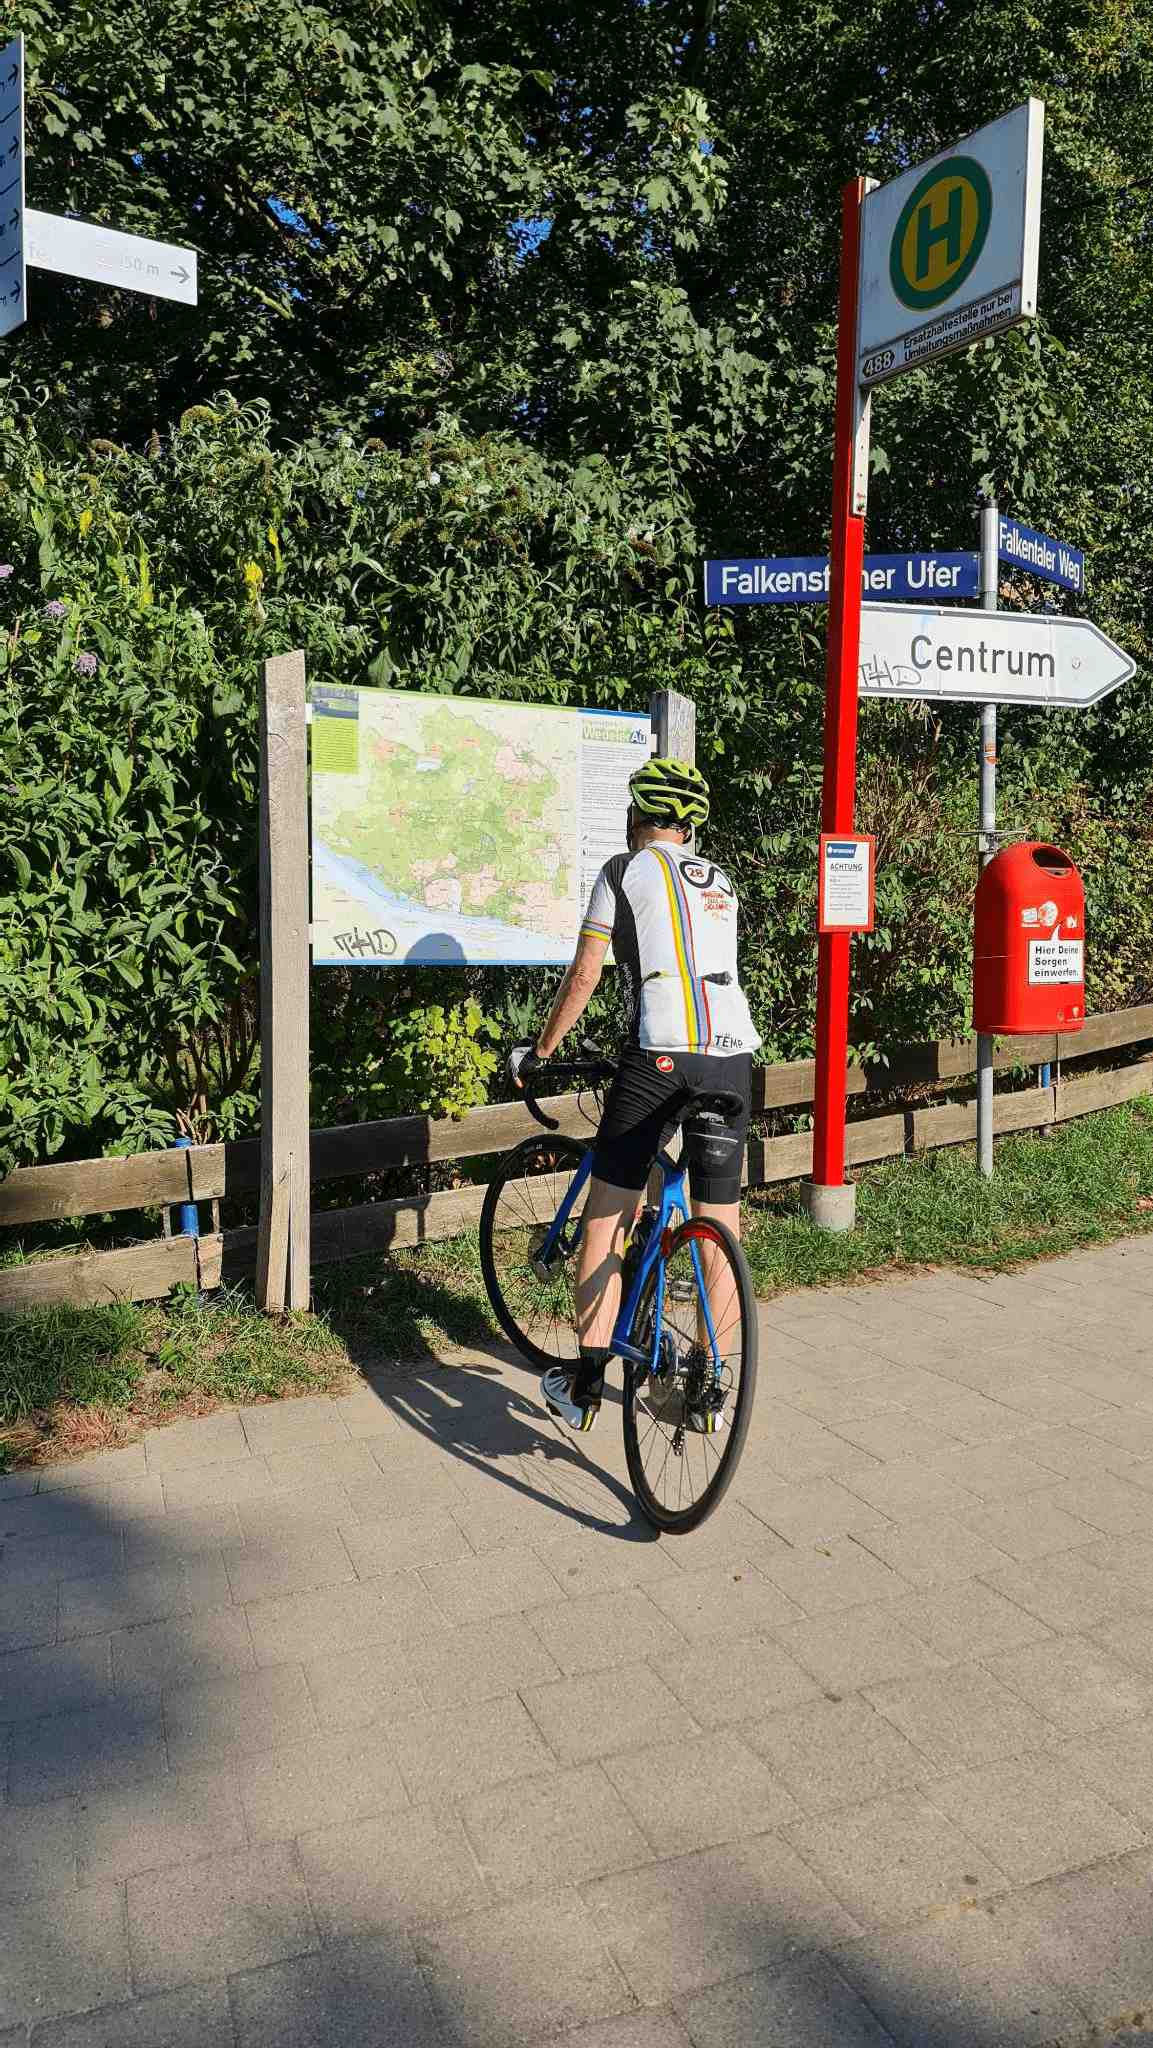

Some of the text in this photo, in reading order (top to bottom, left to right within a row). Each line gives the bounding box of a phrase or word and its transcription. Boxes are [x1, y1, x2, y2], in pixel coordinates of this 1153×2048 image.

[915, 187, 963, 282] H
[903, 290, 1013, 349] Ersatzhaltestelle nur bei
[904, 307, 1012, 362] Umleitungsmaßnahmen
[864, 351, 893, 376] 488
[999, 521, 1080, 589] Falkentaler Weg
[722, 560, 962, 595] Falkenstner Ufer
[910, 635, 1055, 679] Centrum
[830, 863, 863, 873] ACHTUNG
[1035, 945, 1079, 955] Hier Deine
[1035, 957, 1068, 968] Sorgen
